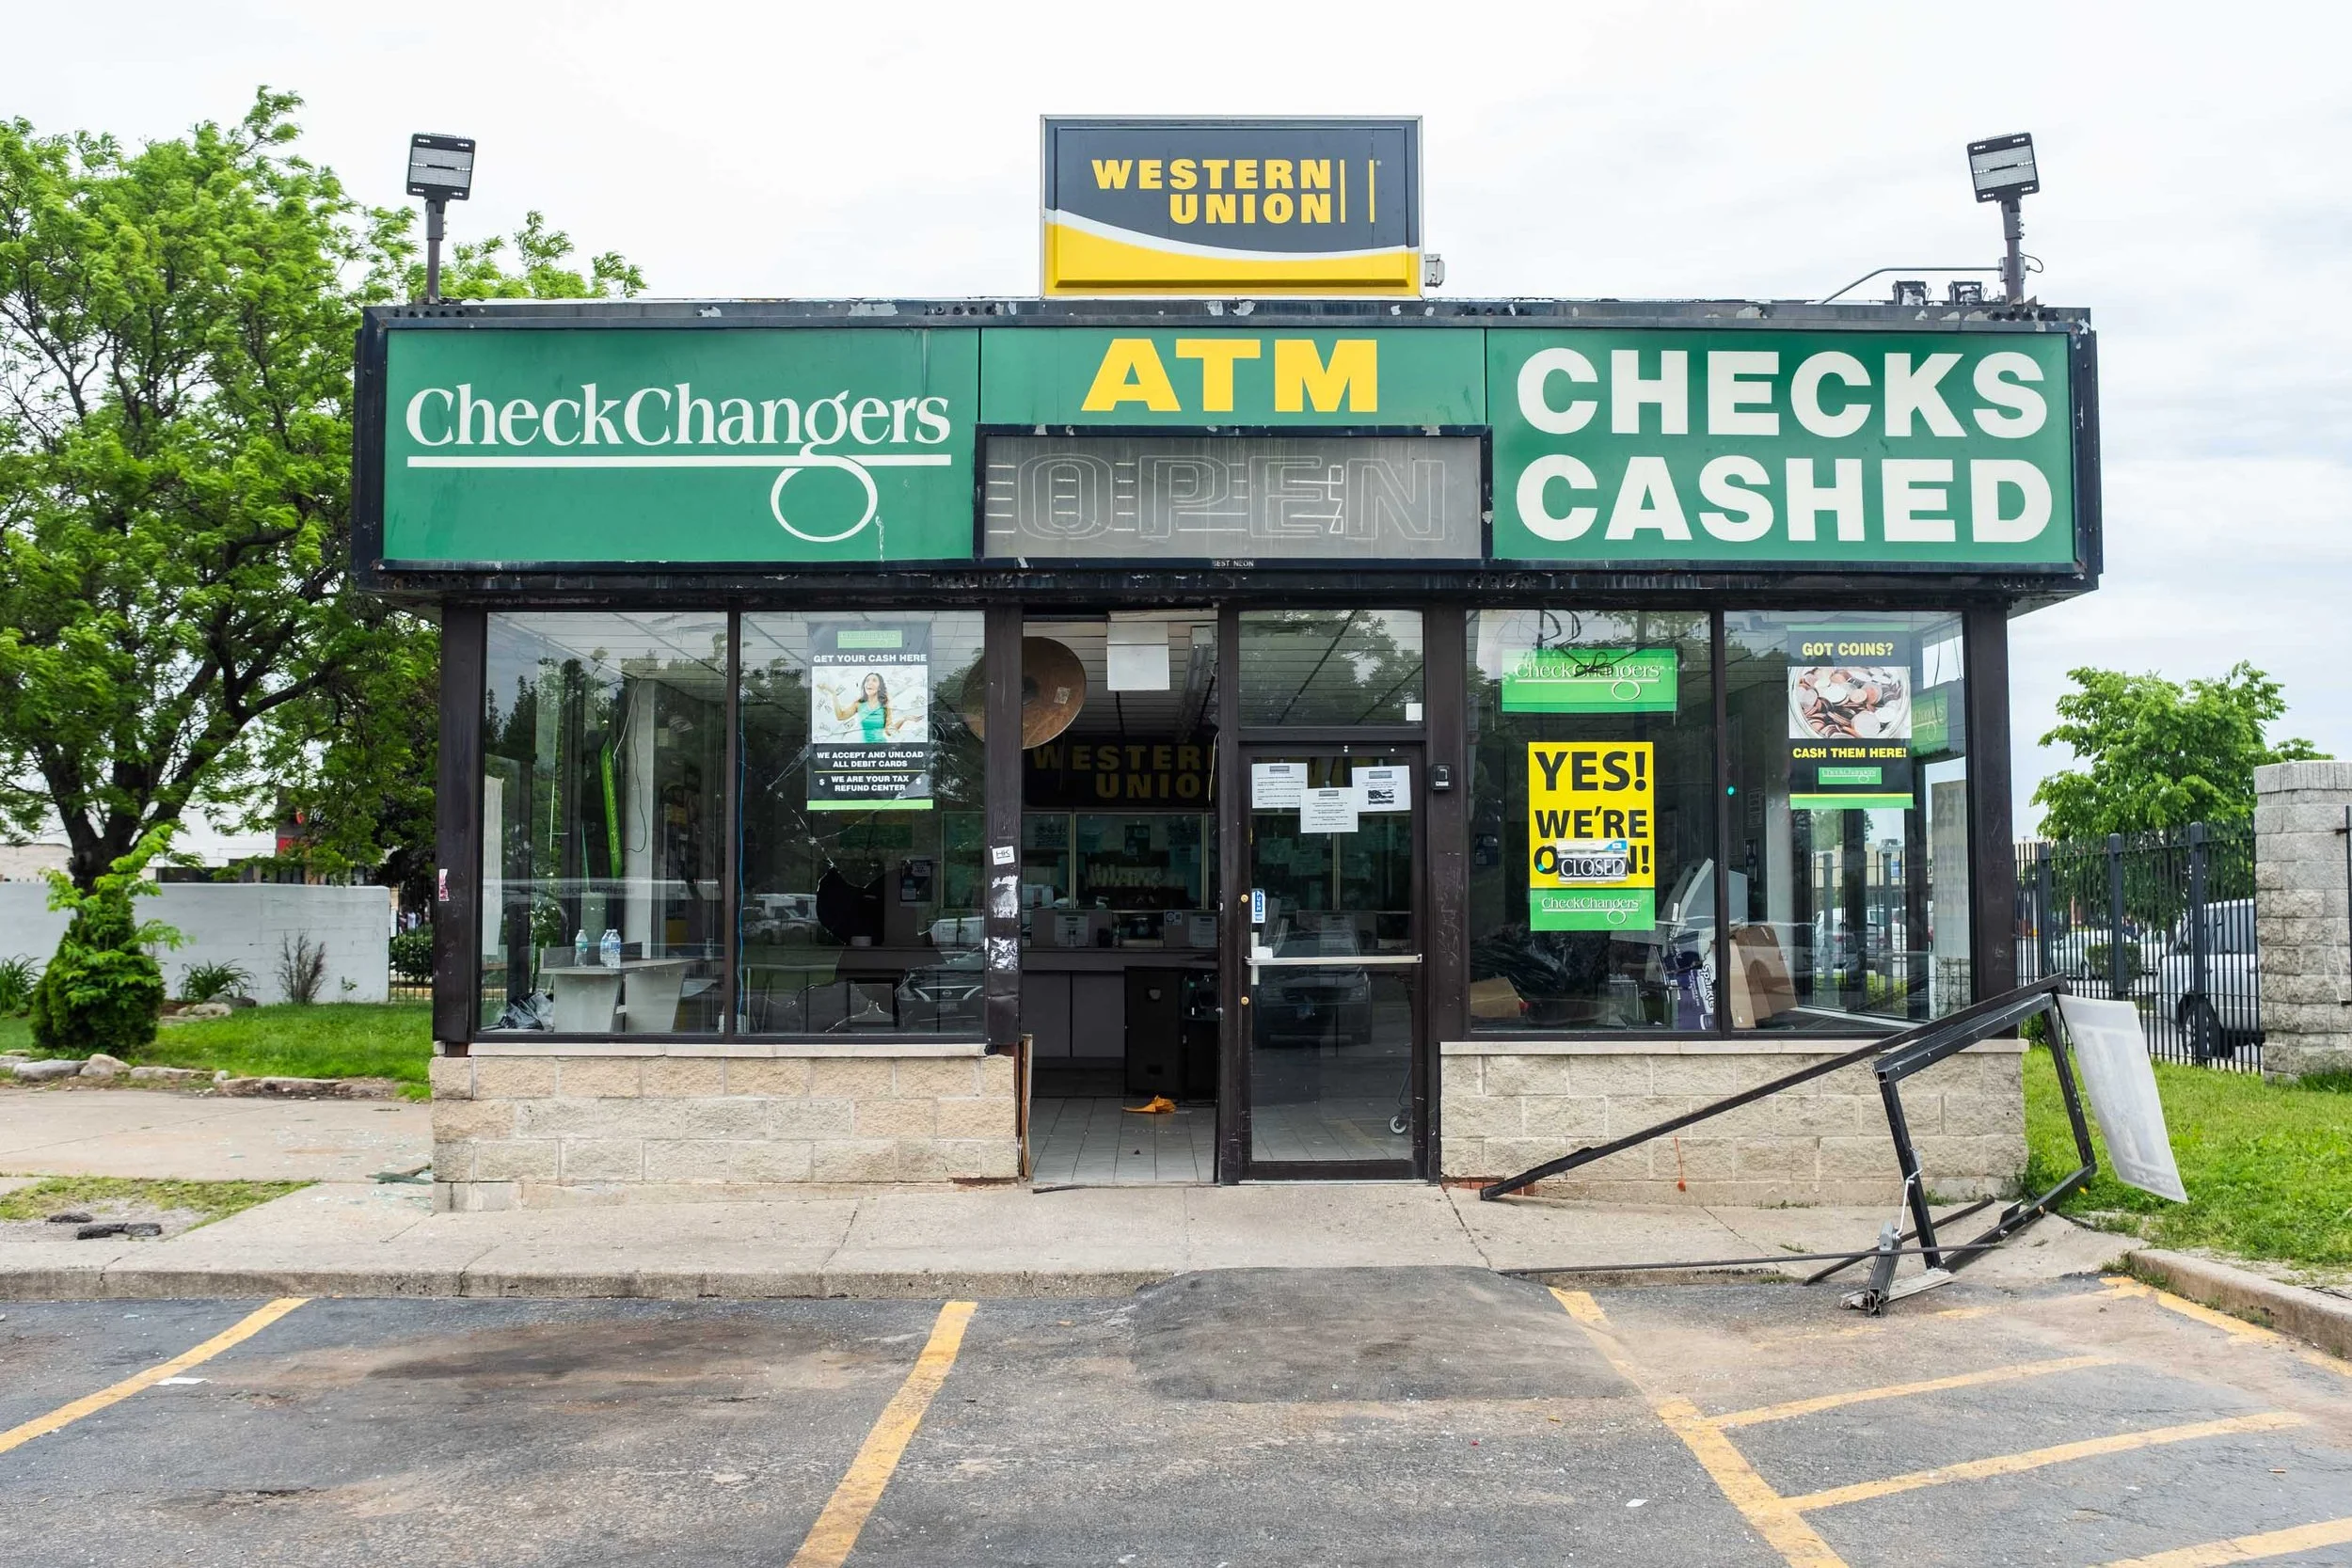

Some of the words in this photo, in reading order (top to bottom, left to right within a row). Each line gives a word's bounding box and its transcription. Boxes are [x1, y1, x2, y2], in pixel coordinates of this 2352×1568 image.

[1091, 158, 1331, 190] WESTERN
[1169, 193, 1331, 224] UNION
[1081, 339, 1377, 412] ATM
[1517, 347, 2048, 439] CHECKS
[405, 383, 951, 543] CheckChangers
[1018, 453, 1446, 542] OPEN
[1516, 454, 2054, 544] CASHED
[814, 655, 834, 663] GET
[836, 655, 866, 663] YOUR
[868, 654, 897, 663] CASH
[899, 654, 927, 662] HERE
[1802, 642, 1834, 657] GOT
[1838, 641, 1894, 657] COINS?
[1792, 747, 1827, 758] CASH
[1830, 747, 1866, 758] THEM
[1869, 747, 1907, 758] HERE!
[1094, 772, 1216, 799] UNIO
[1534, 751, 1647, 791] YES!
[1534, 805, 1647, 839] WE'RE
[1534, 845, 1649, 875] ON!
[1561, 858, 1626, 877] CLOSED
[1542, 896, 1640, 925] CheckChangers
